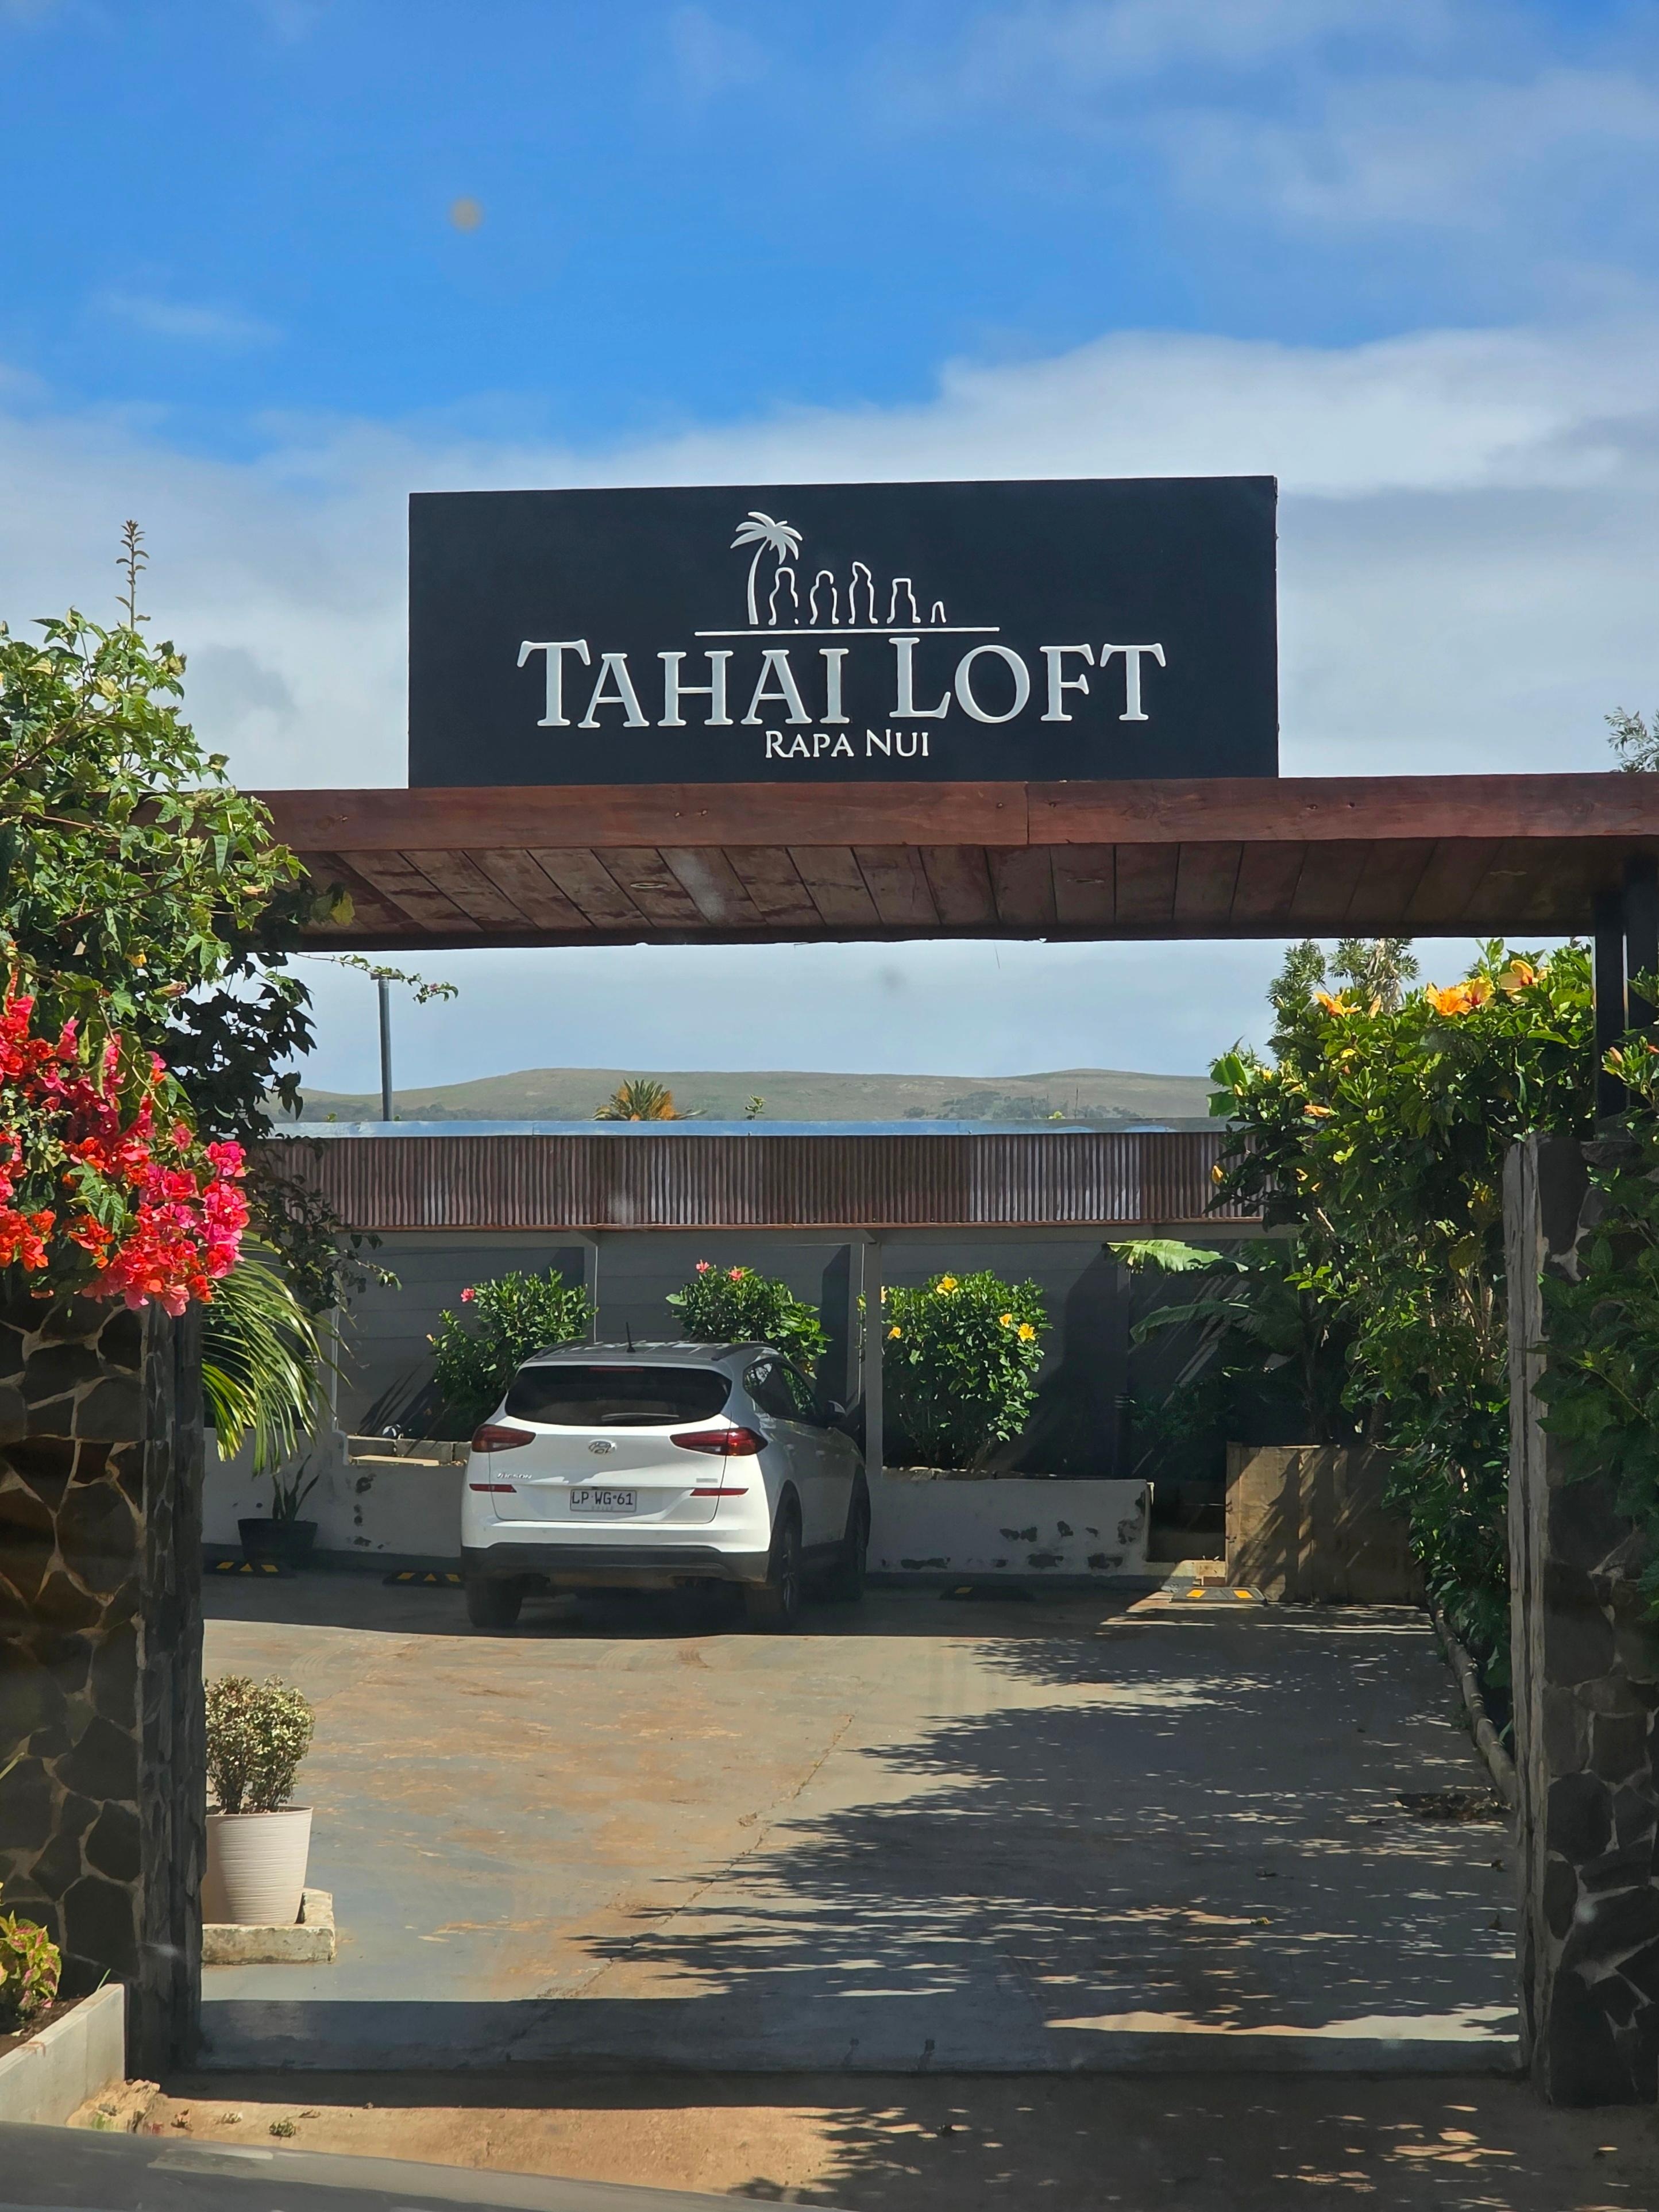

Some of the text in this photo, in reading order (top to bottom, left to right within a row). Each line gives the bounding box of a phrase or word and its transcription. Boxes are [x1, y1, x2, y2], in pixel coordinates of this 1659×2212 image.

[516, 637, 1166, 729] TAHAI LOFT
[765, 729, 929, 758] RAPA NUI
